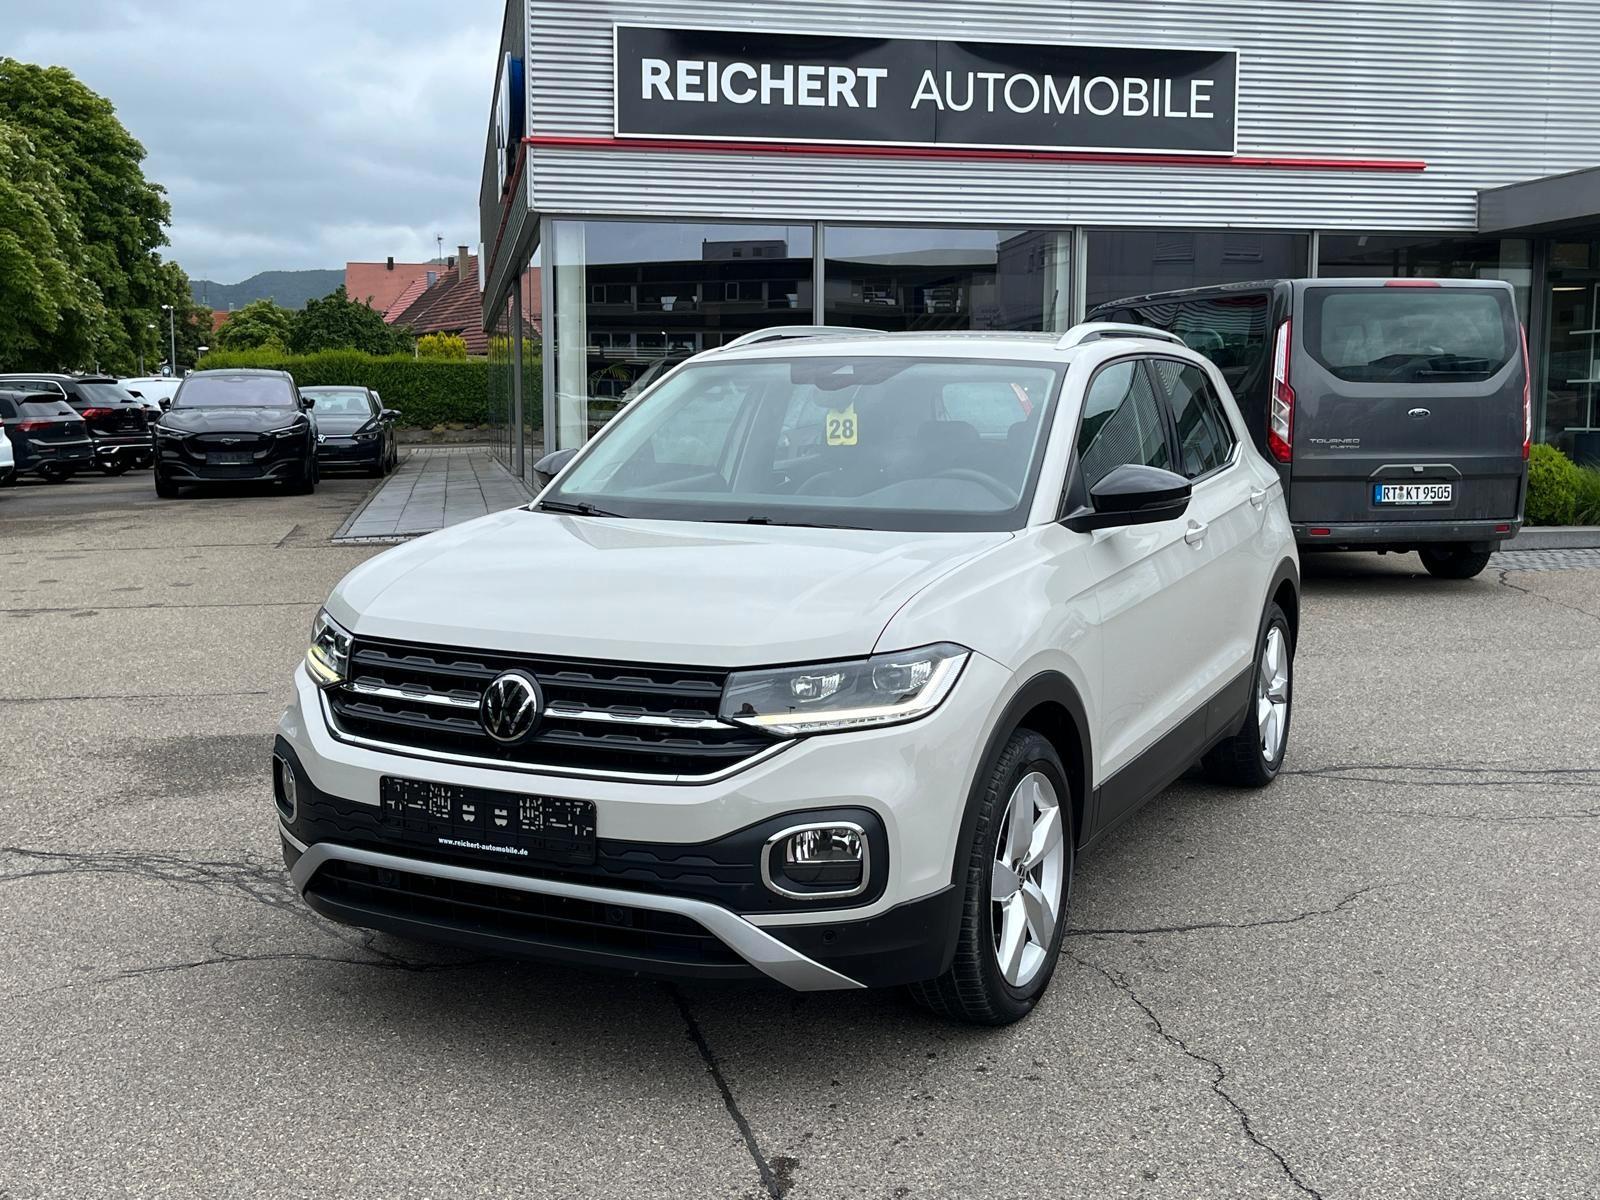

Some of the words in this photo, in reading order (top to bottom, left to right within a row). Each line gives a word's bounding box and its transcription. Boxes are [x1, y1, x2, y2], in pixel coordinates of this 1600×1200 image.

[640, 58, 888, 109] REICHERT
[910, 69, 1215, 119] AUTOMOBILE
[829, 419, 854, 439] 28
[1383, 486, 1398, 500] RT
[1406, 486, 1421, 500] KT
[1423, 486, 1450, 500] 9505
[438, 837, 529, 856] www.reichert-automobile.de
